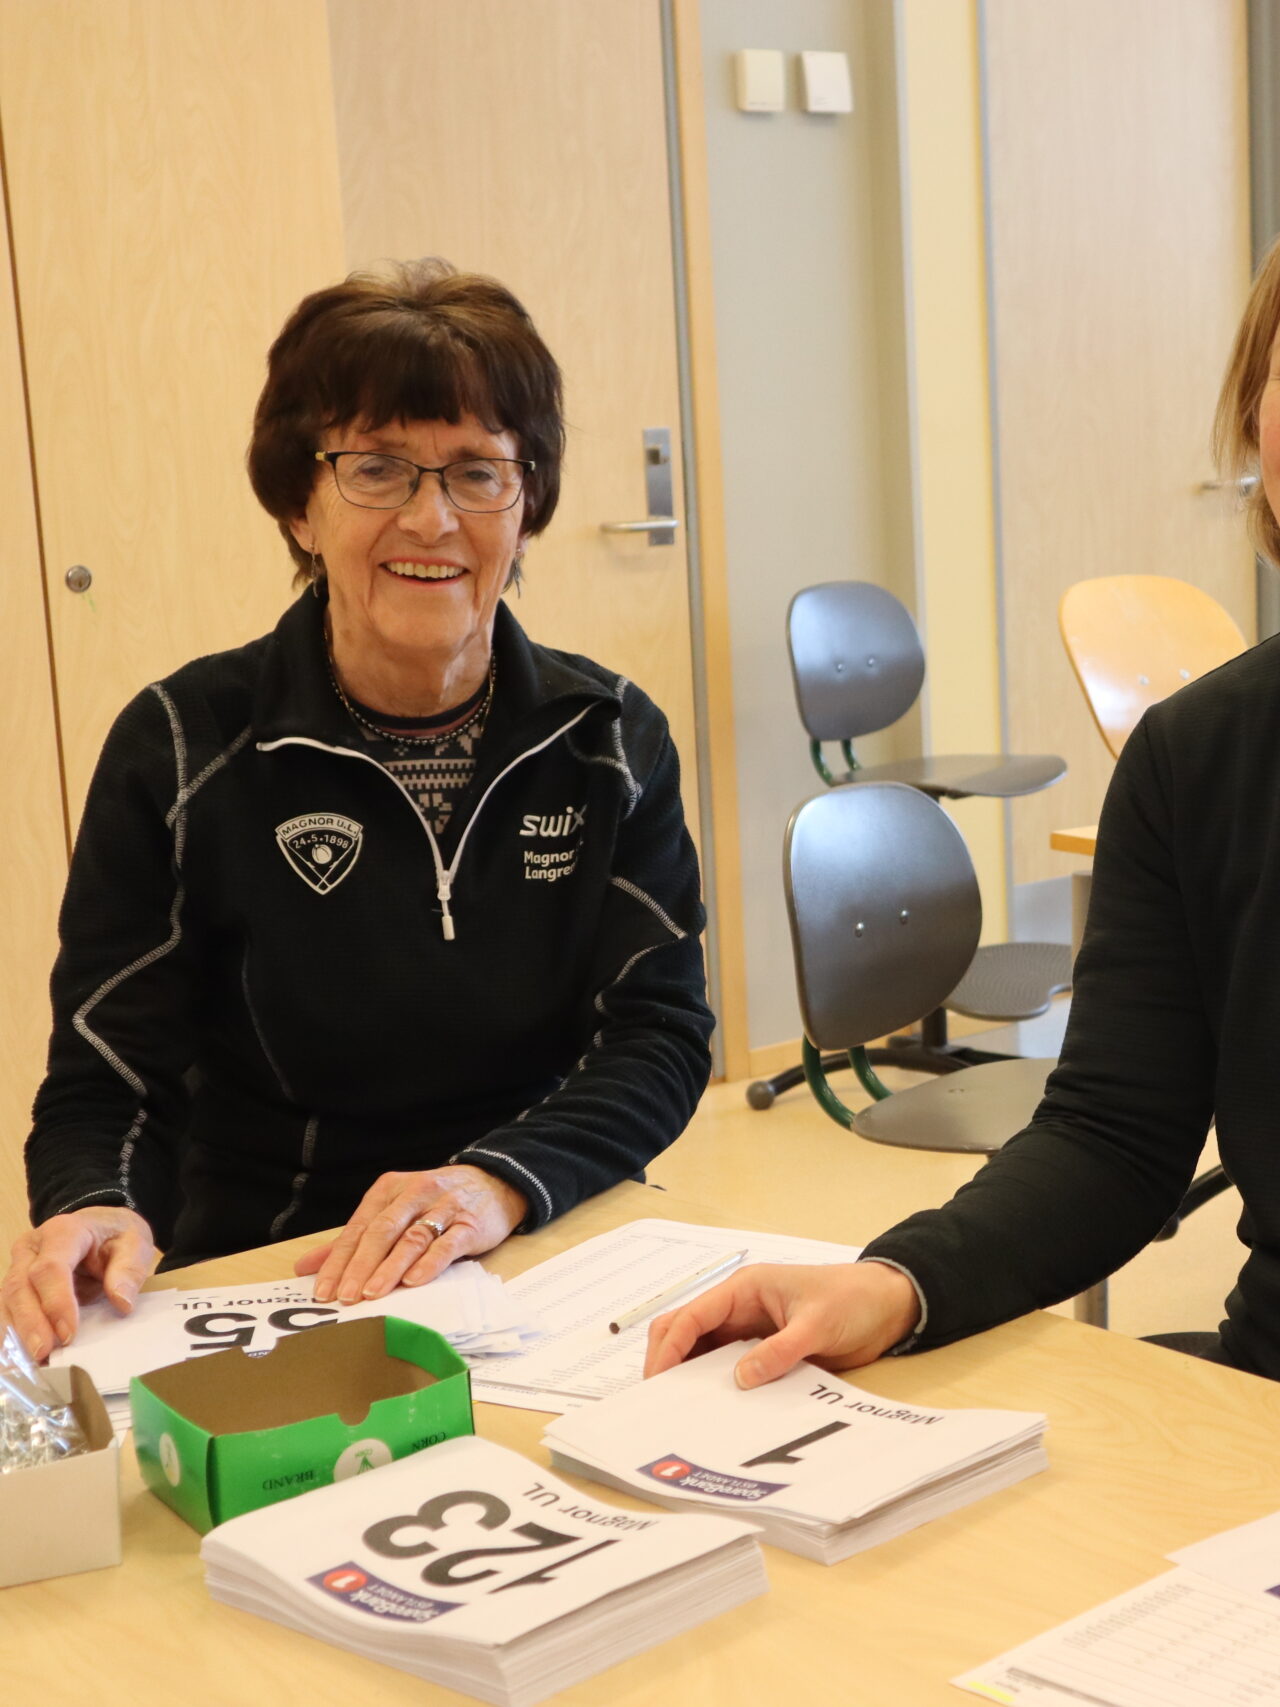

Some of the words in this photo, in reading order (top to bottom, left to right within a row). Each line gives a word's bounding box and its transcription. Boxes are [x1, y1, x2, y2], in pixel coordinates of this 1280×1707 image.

[281, 817, 334, 836] MAGNOR
[336, 820, 357, 835] U.L.
[292, 834, 349, 849] 24.5.1898
[523, 849, 575, 867] Magnor
[224, 1296, 321, 1307] agnor
[809, 1384, 844, 1406] UL
[844, 1401, 944, 1426] Magnor
[738, 1420, 852, 1469] 1
[262, 1470, 314, 1491] BRAND
[680, 1476, 767, 1500] SpareBank
[523, 1482, 560, 1507] UL
[558, 1504, 659, 1531] Magnor
[362, 1490, 622, 1594] 123
[350, 1588, 440, 1623] SpareBank
